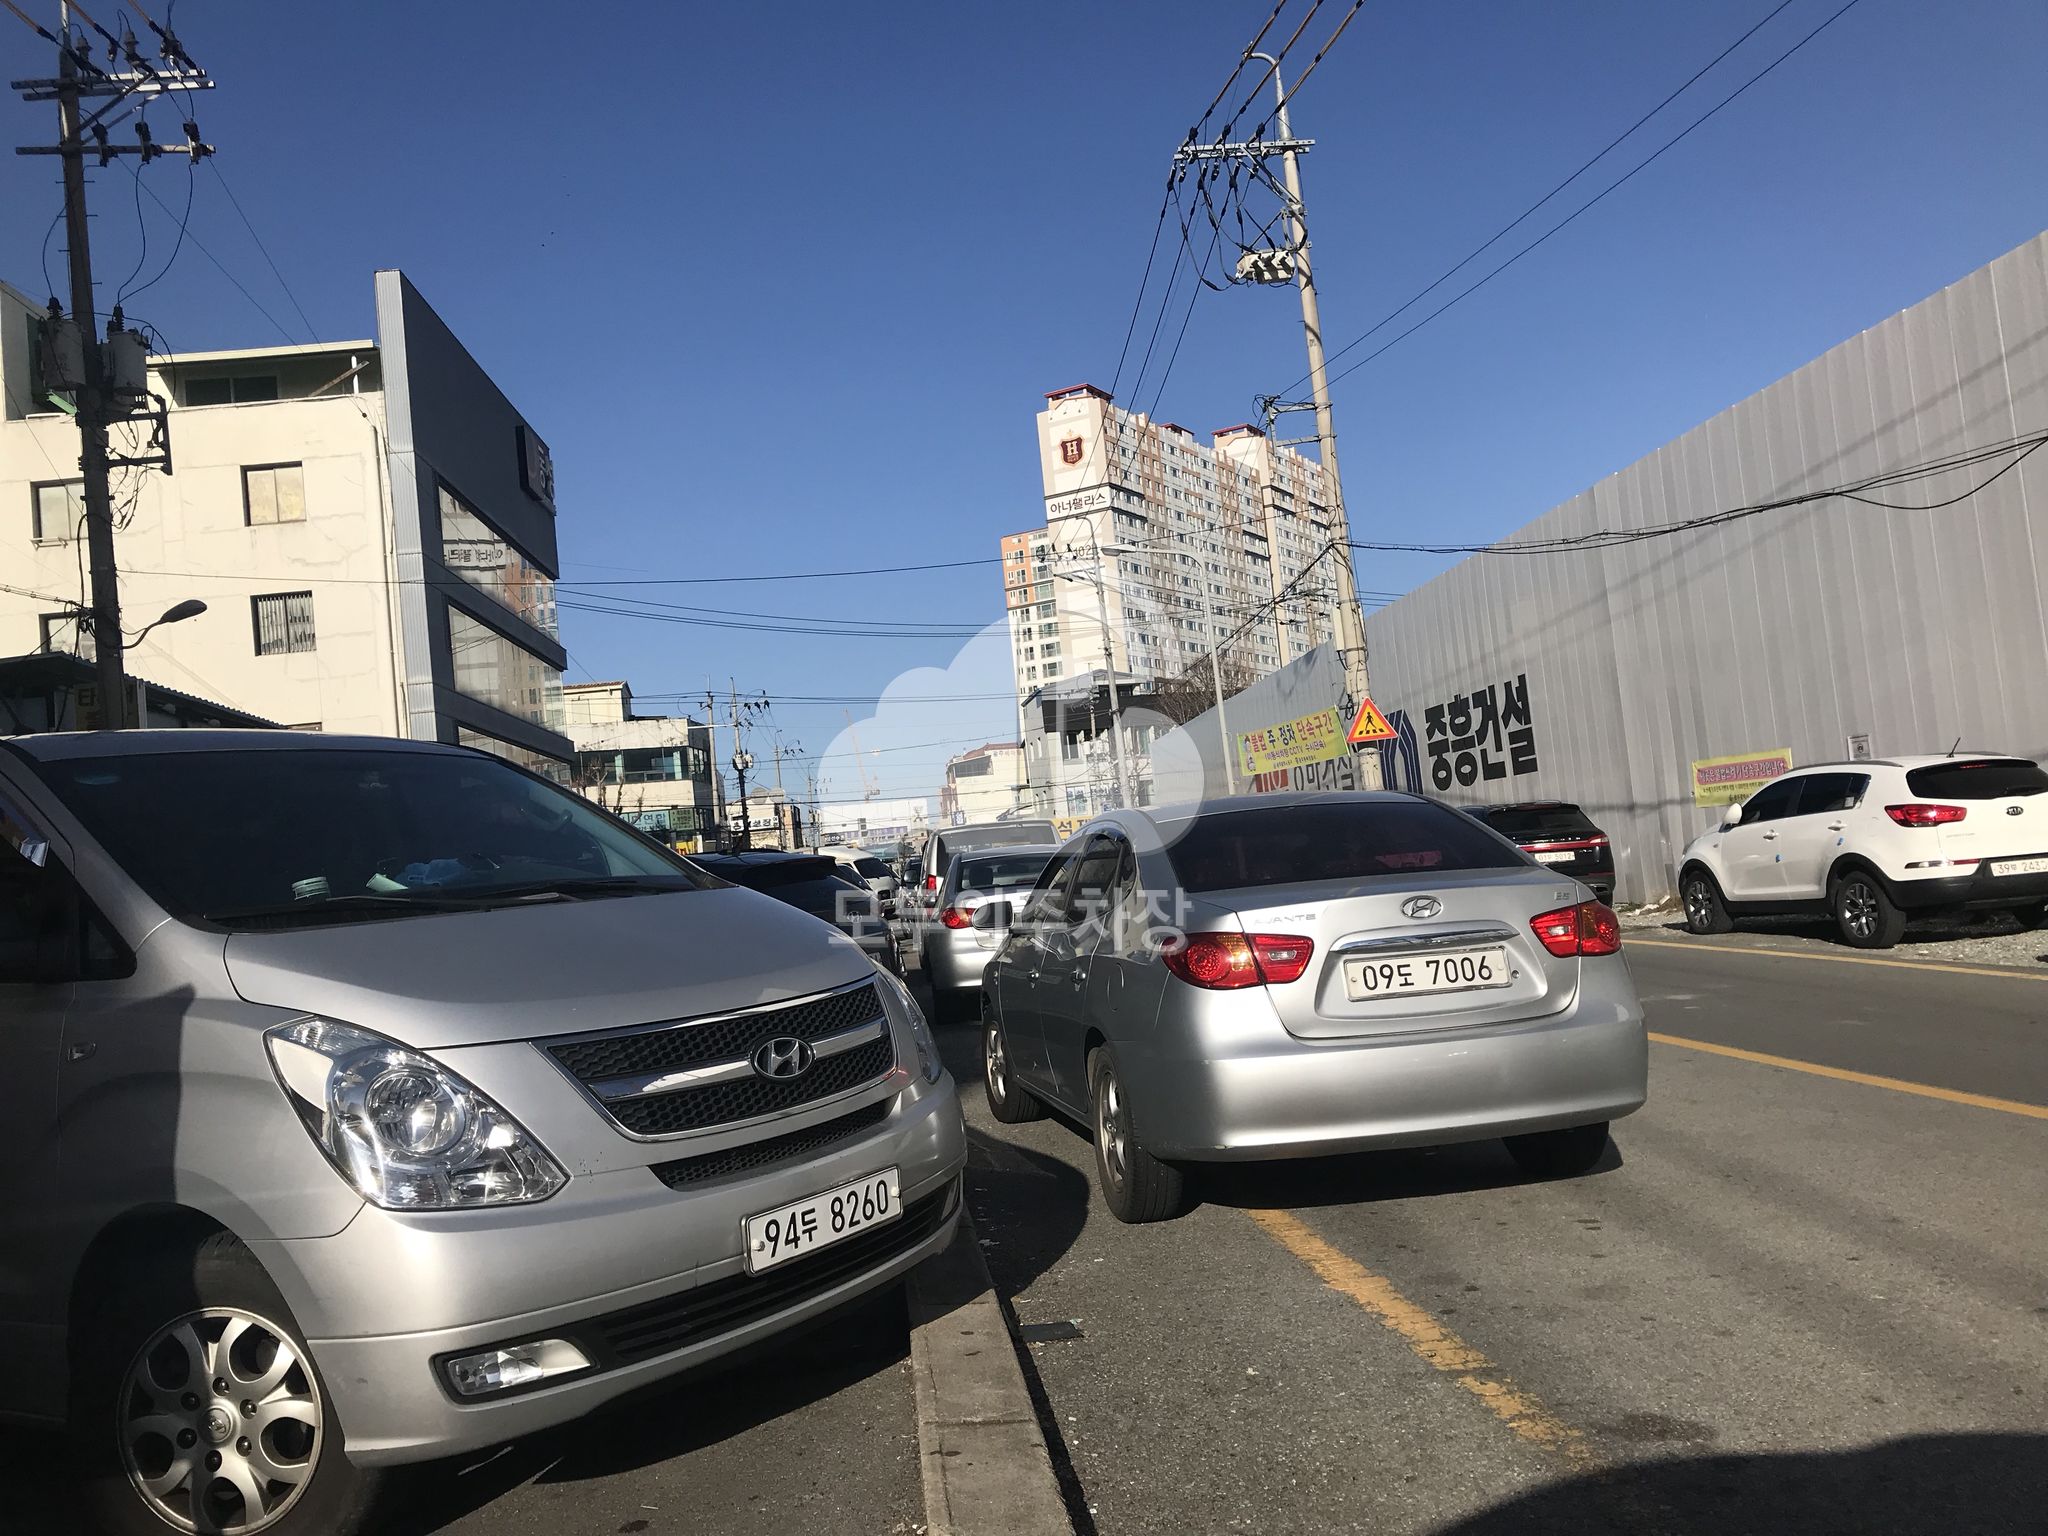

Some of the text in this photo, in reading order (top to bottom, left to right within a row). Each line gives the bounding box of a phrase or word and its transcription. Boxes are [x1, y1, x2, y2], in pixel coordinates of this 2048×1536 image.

[1251, 731, 1267, 753] 불법
[1296, 711, 1335, 741] 단속구간
[1424, 674, 1538, 791] 중흥건설
[2007, 807, 2023, 815] KIA
[1362, 955, 1493, 992] 09도 7006
[764, 1179, 889, 1258] 94두 8260
